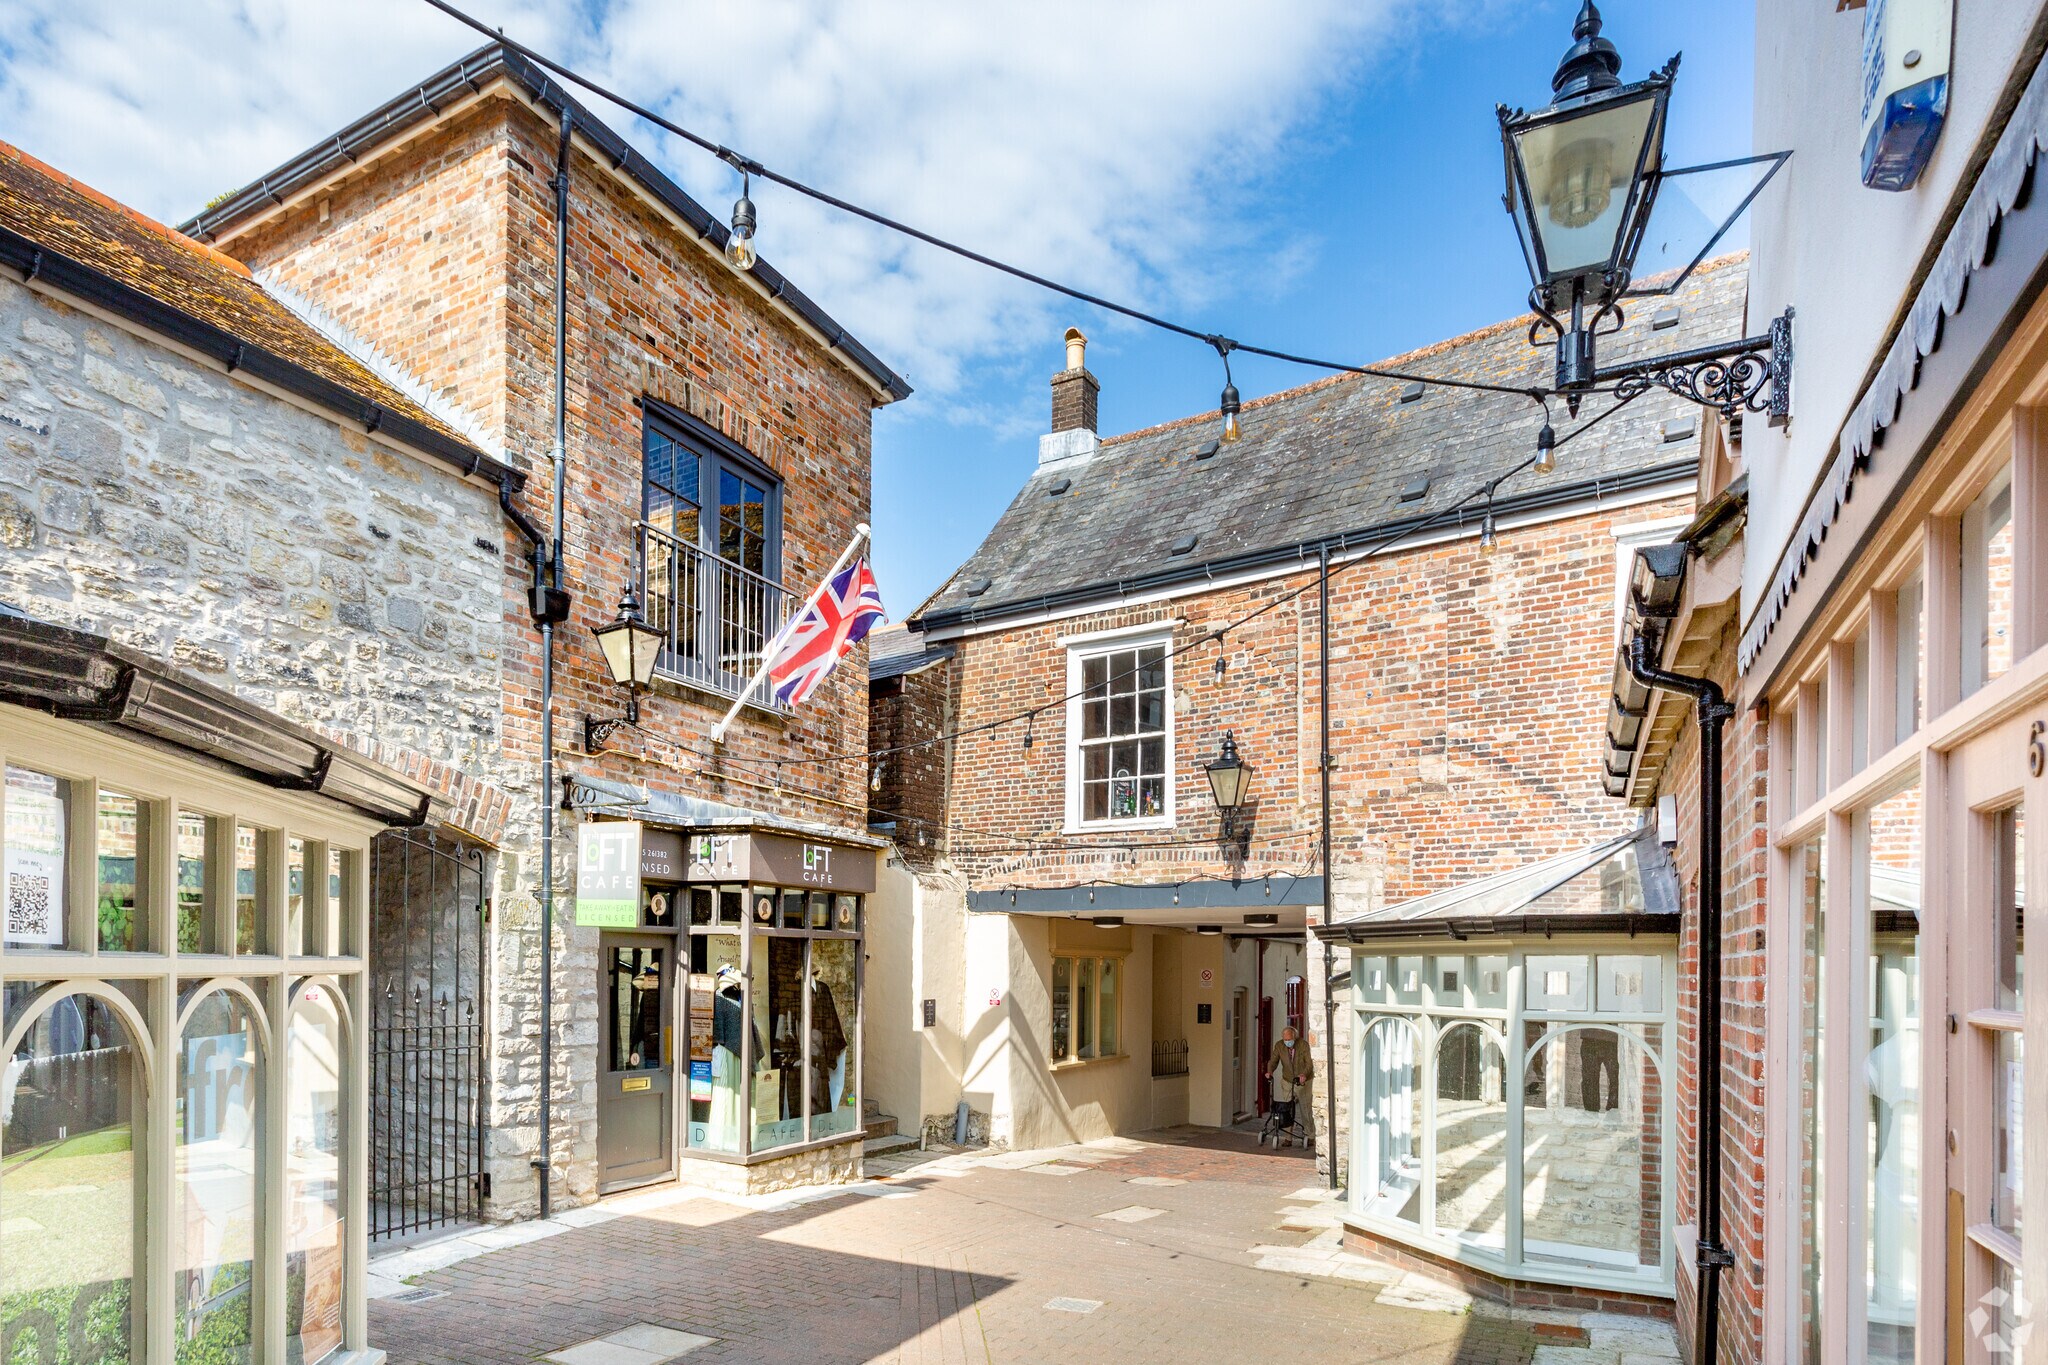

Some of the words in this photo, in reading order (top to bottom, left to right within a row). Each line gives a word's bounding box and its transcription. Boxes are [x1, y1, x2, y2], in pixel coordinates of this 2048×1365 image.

[2029, 720, 2046, 778] 6
[581, 832, 635, 872] LOFT
[803, 843, 833, 872] LOFT
[696, 865, 738, 876] CAFE
[803, 872, 833, 884] CAFE
[581, 875, 633, 889] CAFE
[578, 913, 635, 922] LICENSED
[757, 1124, 796, 1143] CAFE
